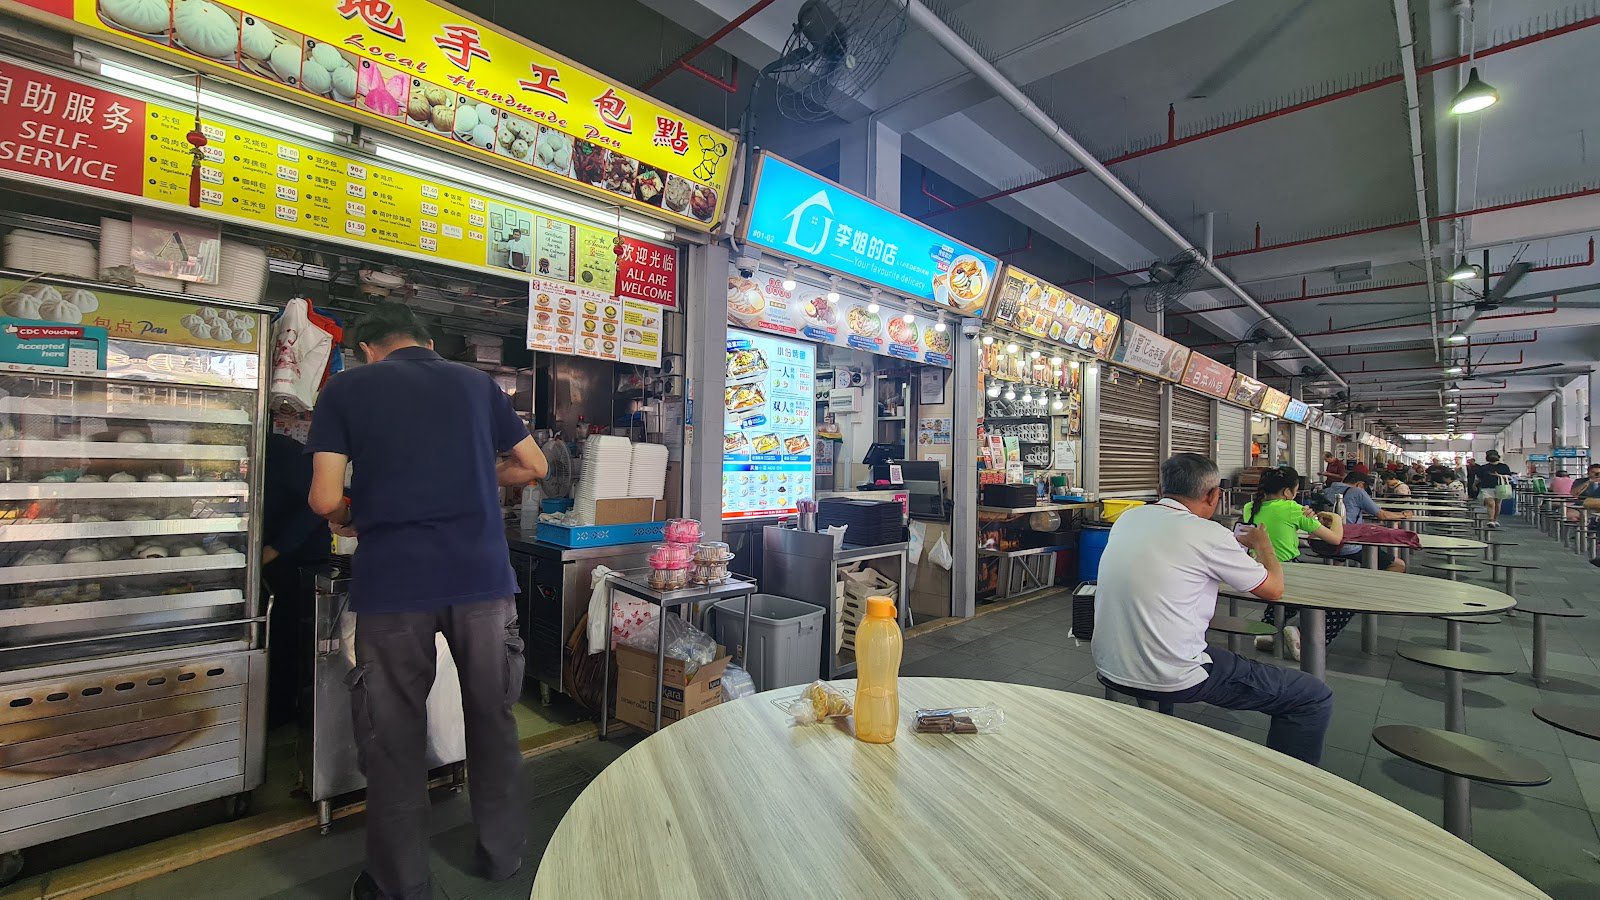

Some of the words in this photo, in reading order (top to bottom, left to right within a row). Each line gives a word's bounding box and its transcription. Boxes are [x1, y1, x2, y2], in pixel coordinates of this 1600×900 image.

[343, 33, 428, 73] Local
[446, 74, 568, 127] Handmade
[583, 123, 621, 148] Pau
[0, 70, 133, 134] 自助服务
[162, 116, 179, 124] 大包
[18, 120, 98, 150] SELF-
[204, 126, 224, 137] $2.00
[161, 137, 188, 149] 鸡肉包
[244, 138, 267, 149] 叉烧包
[161, 145, 180, 153] Chicken
[203, 147, 223, 156] $2.00
[0, 141, 118, 182] SERVICE
[161, 158, 178, 168] 菜包
[316, 157, 337, 167] 豆沙包
[202, 168, 223, 177] $1.20
[279, 167, 297, 176] $1.00
[160, 181, 186, 190] 三合一
[277, 186, 295, 196] $1.00
[201, 189, 222, 199] $1.20
[242, 199, 265, 210] 玉米包
[278, 206, 296, 215] $1.00
[348, 222, 364, 230] $1.50
[753, 230, 774, 243] #01-02
[835, 224, 898, 266] 李姐的店
[621, 243, 674, 272] 欢迎光临
[626, 268, 645, 281] ALL
[648, 273, 668, 286] ARE
[854, 257, 869, 269] Your
[871, 261, 899, 281] favourite
[901, 274, 925, 290] delicacy
[622, 280, 672, 301] WELCOME
[93, 316, 133, 333] 包点
[137, 320, 168, 335] Pau
